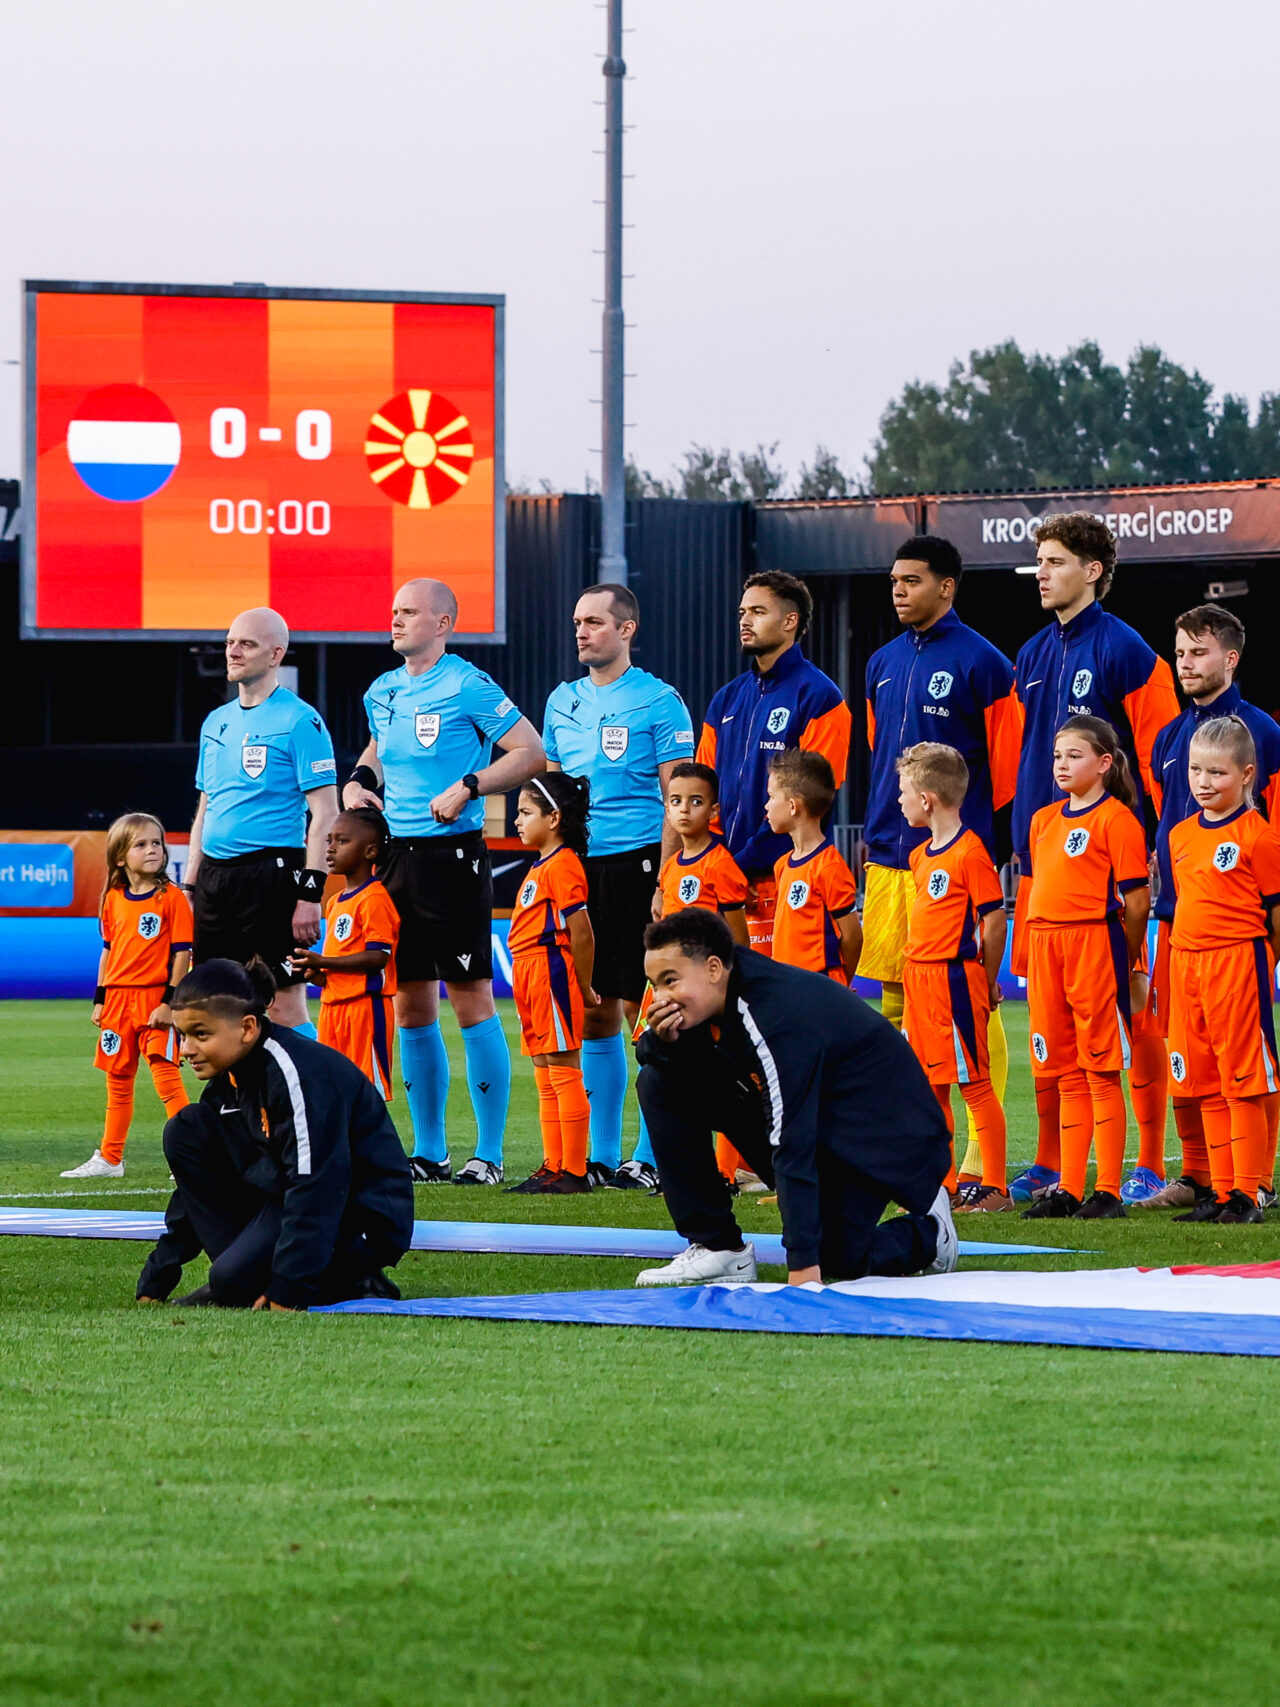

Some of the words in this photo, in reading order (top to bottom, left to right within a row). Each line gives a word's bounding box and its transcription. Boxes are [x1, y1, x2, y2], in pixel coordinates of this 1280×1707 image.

[210, 498, 331, 536] 00:00
[760, 741, 775, 750] ING
[21, 863, 69, 886] Heijn
